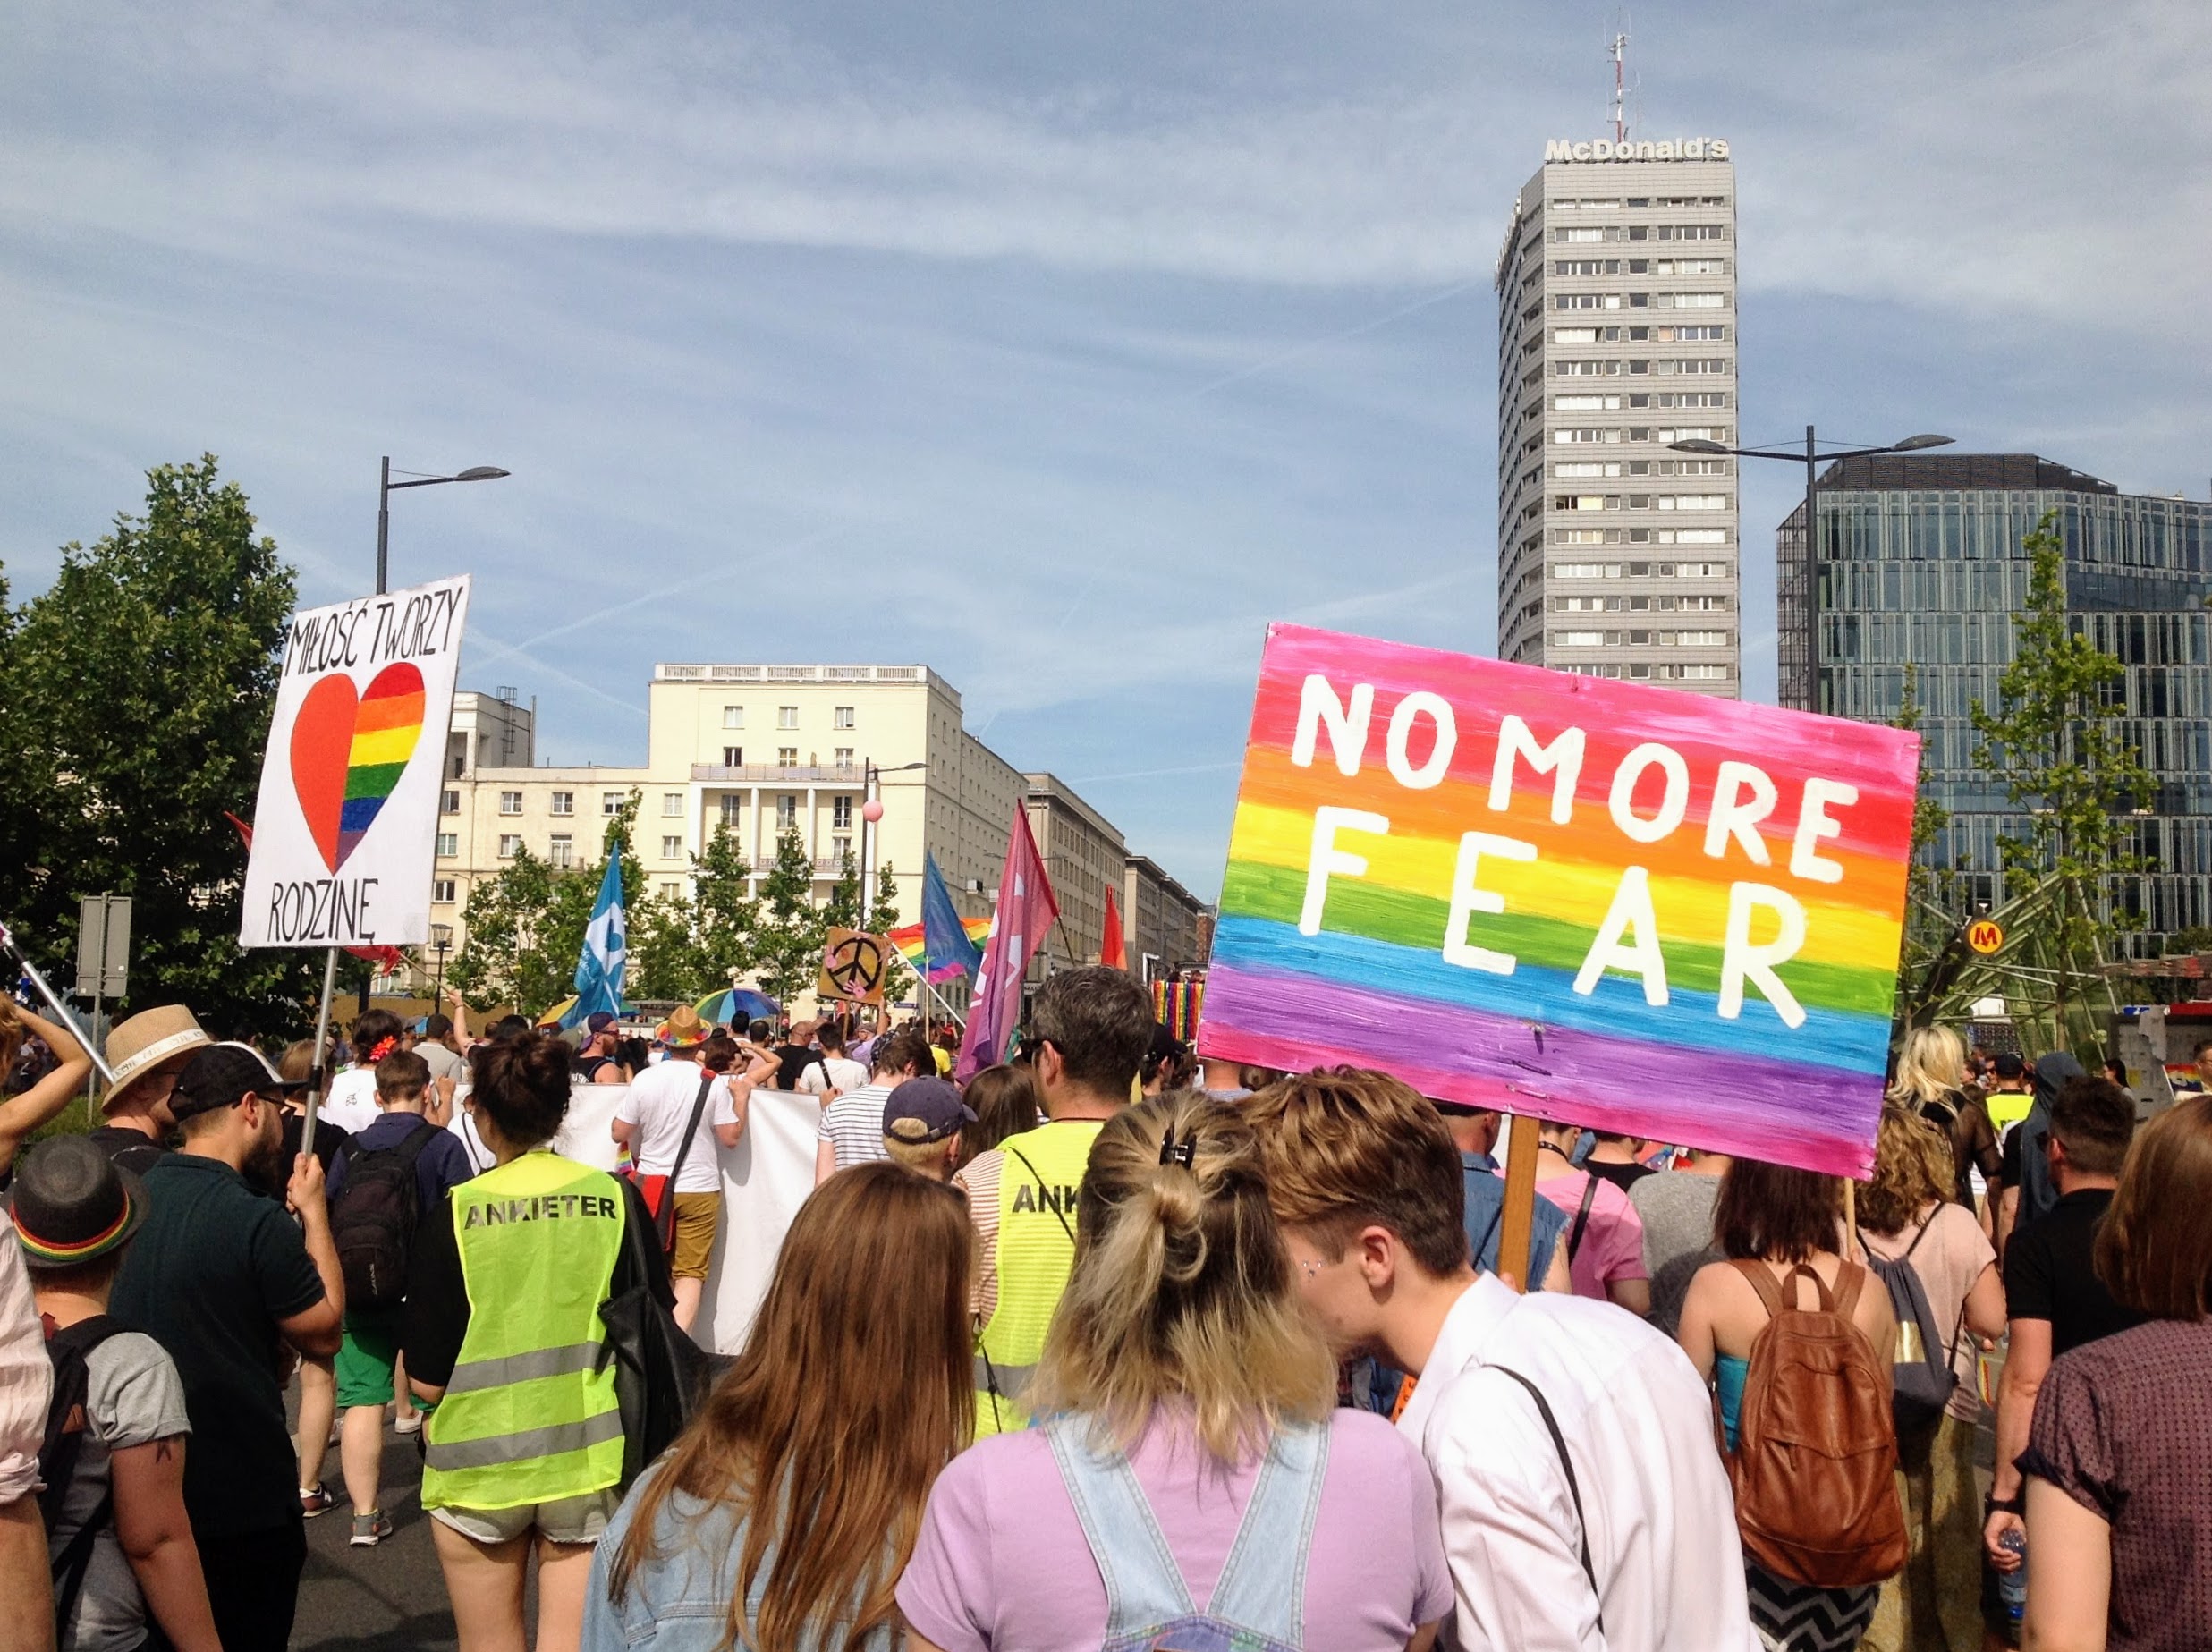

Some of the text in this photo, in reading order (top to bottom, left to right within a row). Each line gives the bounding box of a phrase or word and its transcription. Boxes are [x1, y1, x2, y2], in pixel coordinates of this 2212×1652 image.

[1544, 137, 1730, 160] McDonald's
[284, 586, 464, 677] MIŁOŚĆ TWORZY
[1291, 674, 1860, 883] NO MORE
[267, 877, 379, 945] RODZINĘ
[1297, 805, 1808, 1029] FEAR
[464, 1194, 617, 1231] ANKIETER
